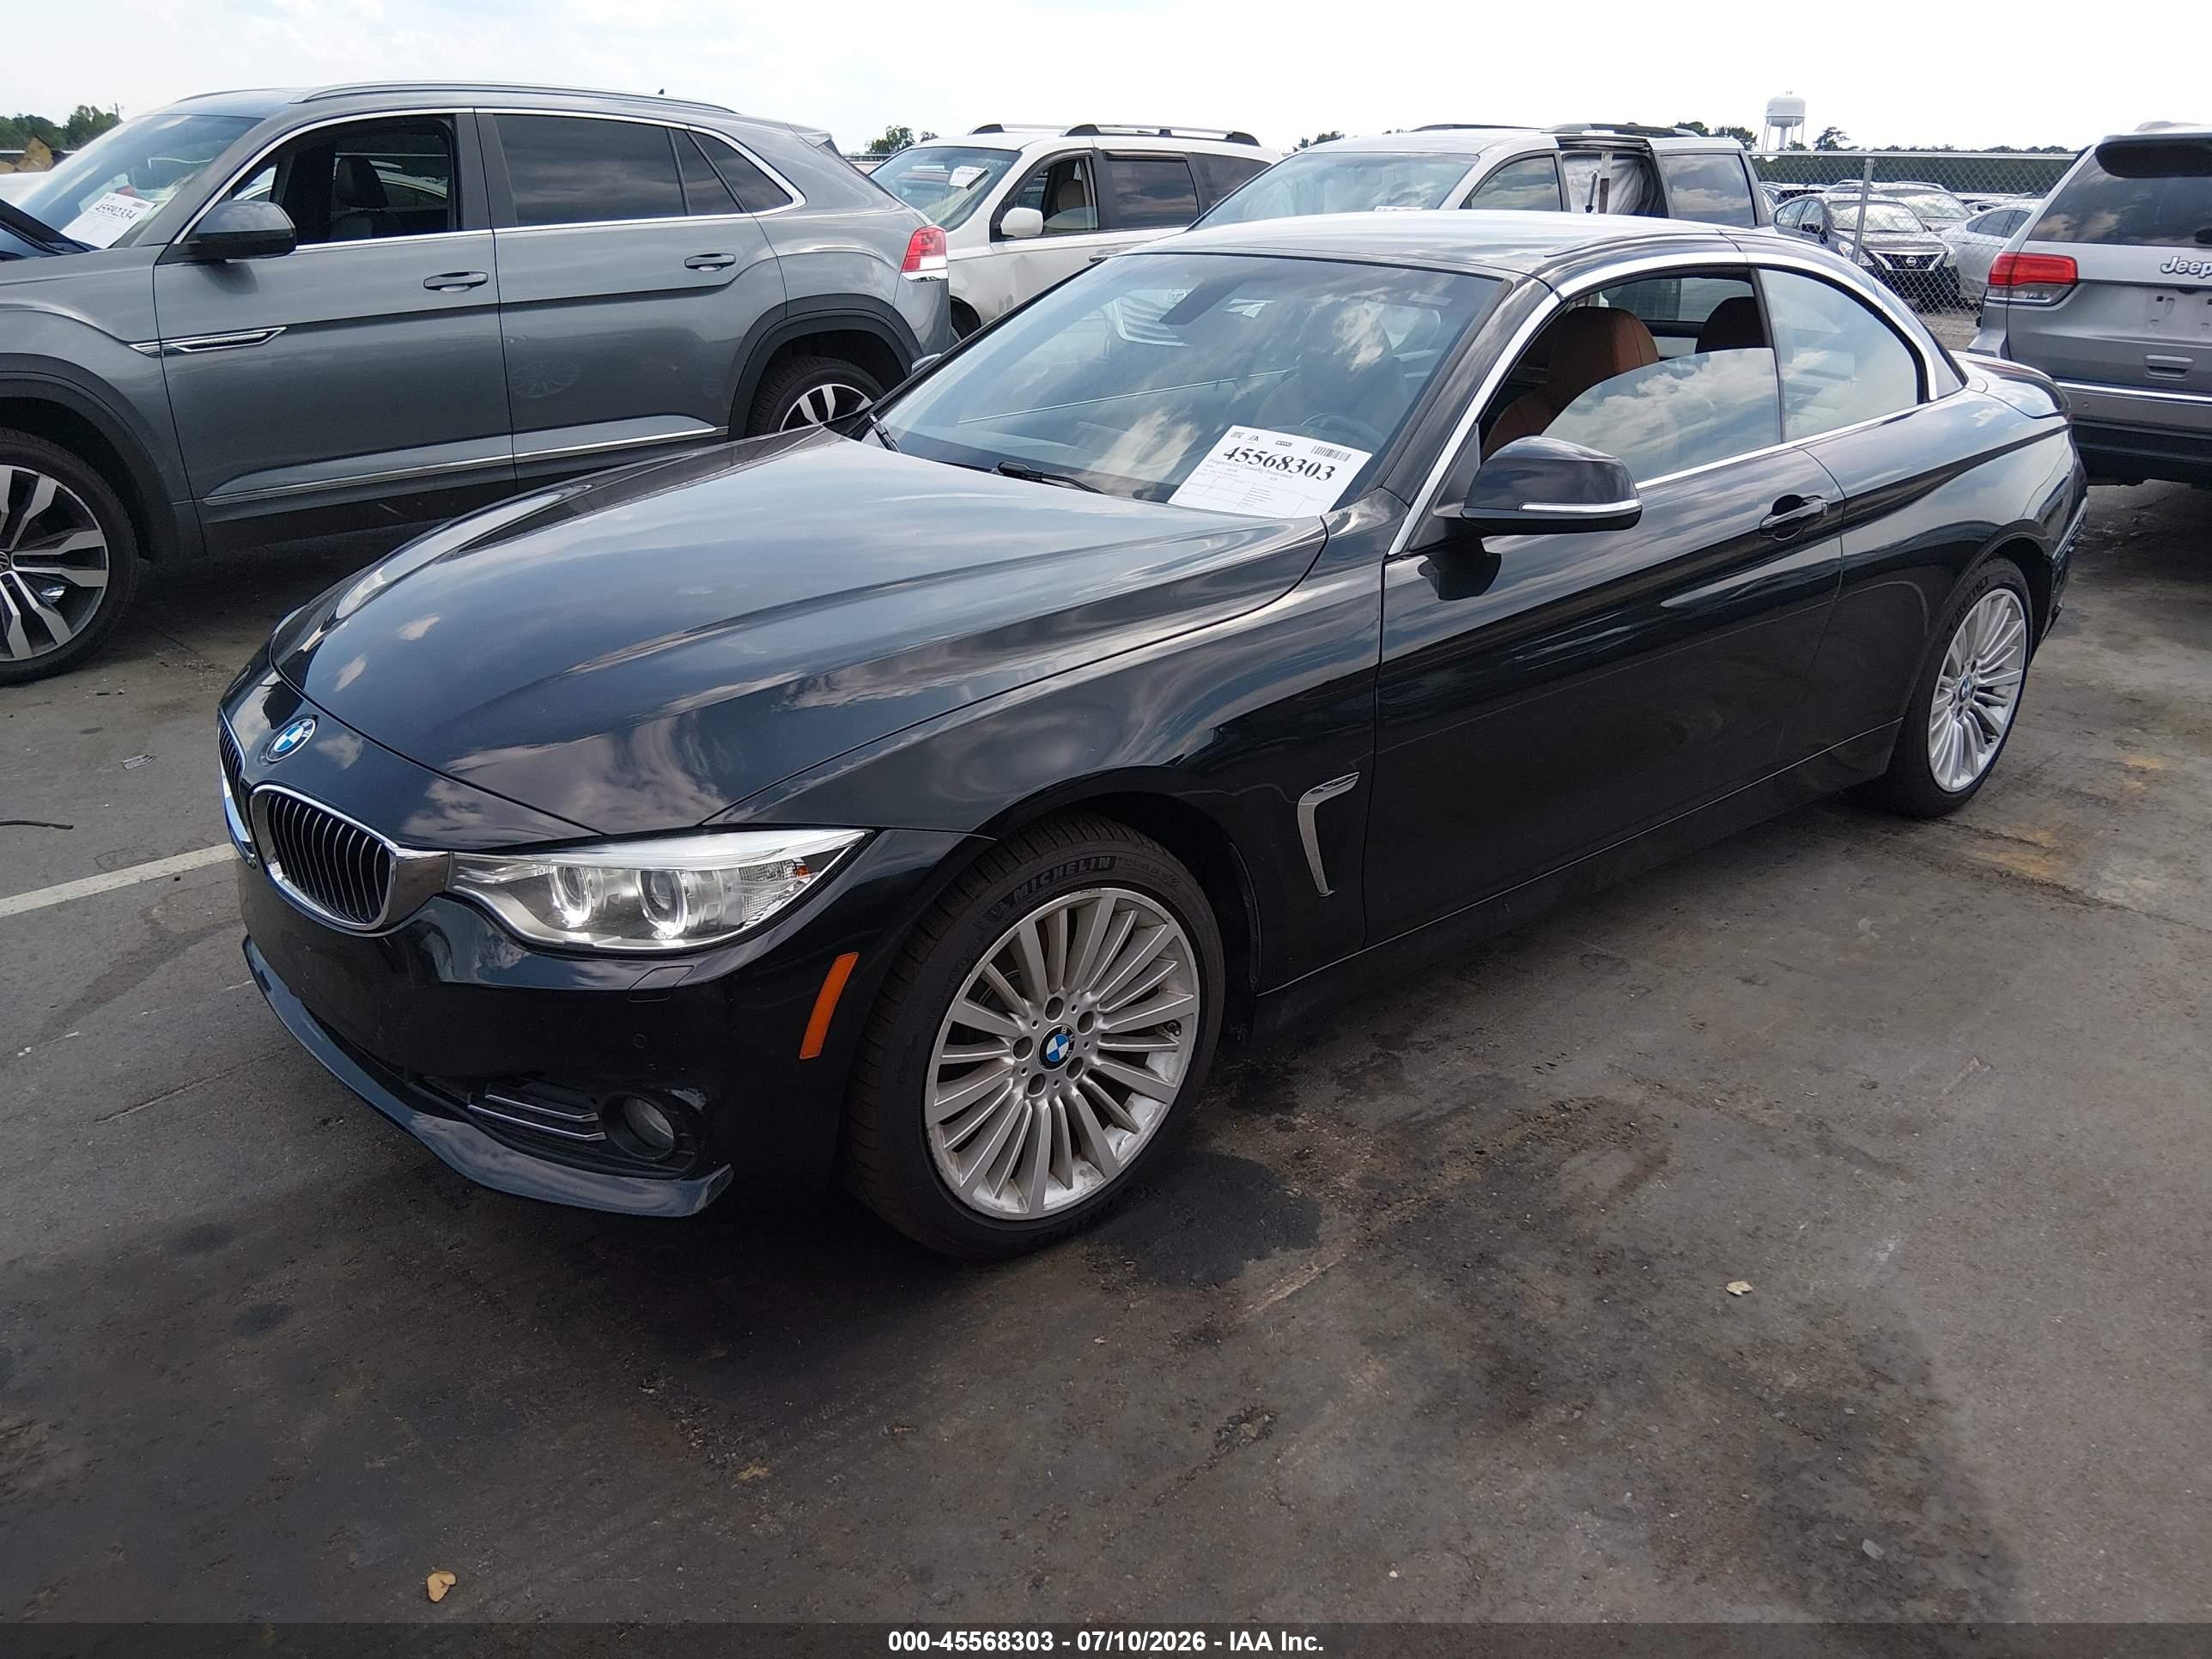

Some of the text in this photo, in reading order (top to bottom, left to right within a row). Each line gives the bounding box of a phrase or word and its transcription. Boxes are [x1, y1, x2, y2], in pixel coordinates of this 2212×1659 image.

[2160, 255, 2212, 278] Jeep
[1223, 446, 1336, 482] 45568303
[1012, 855, 1115, 901] MICHELIN
